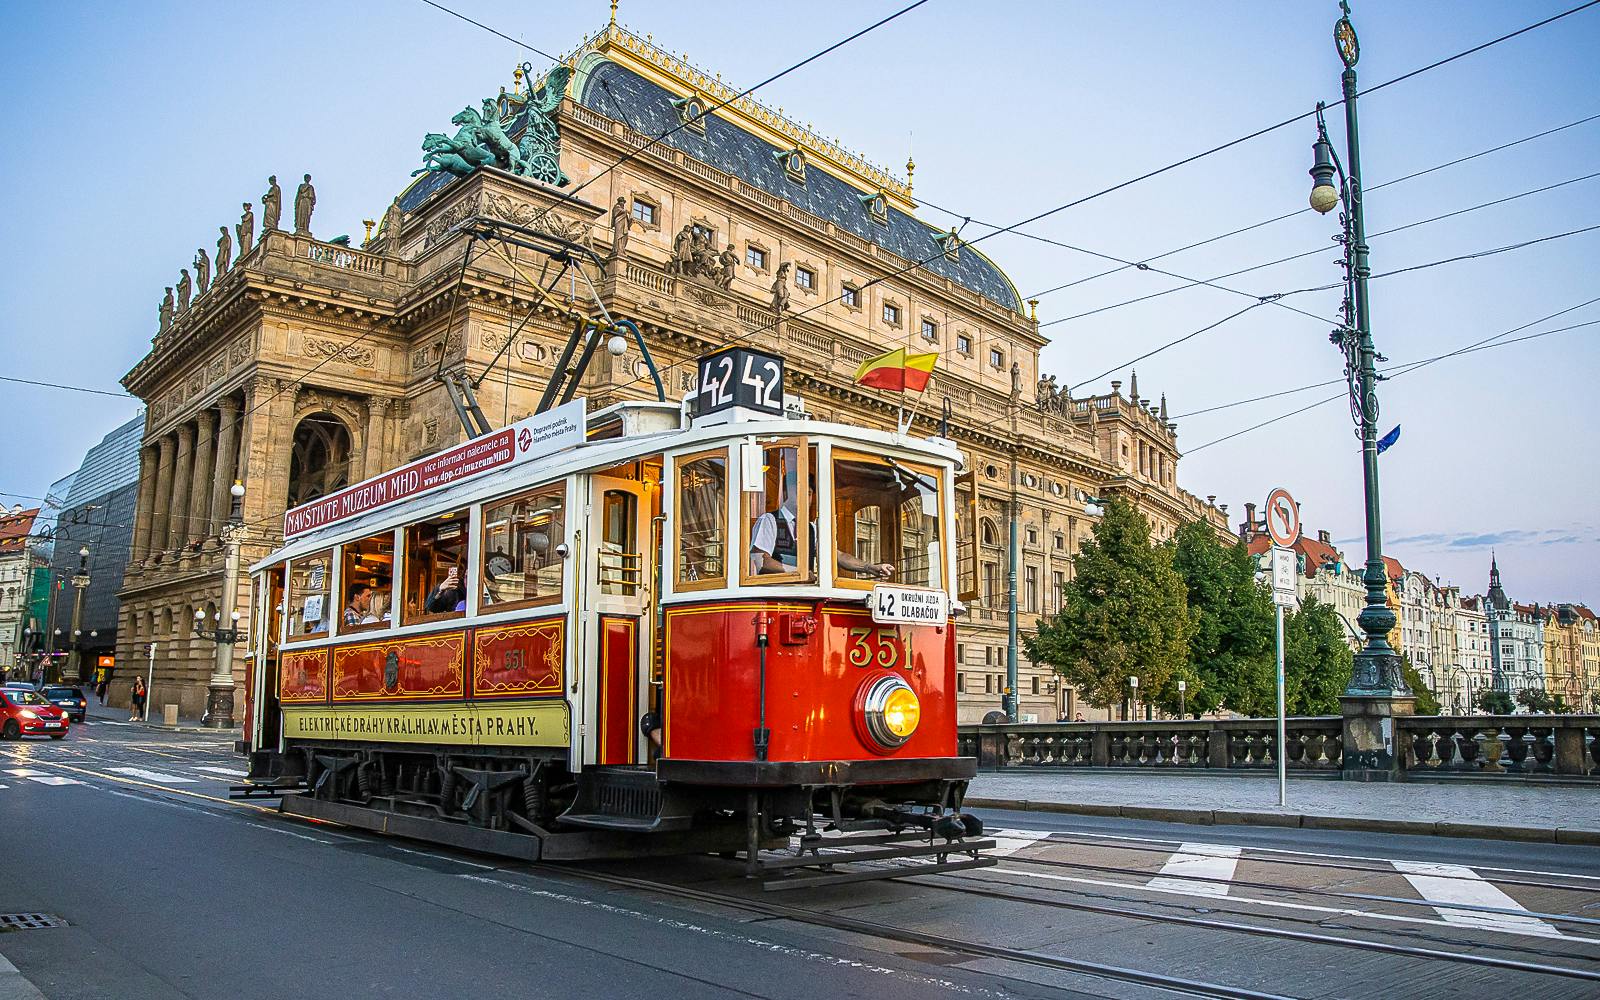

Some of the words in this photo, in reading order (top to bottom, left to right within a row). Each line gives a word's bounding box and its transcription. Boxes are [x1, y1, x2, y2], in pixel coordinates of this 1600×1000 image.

[701, 356, 733, 408] 42
[741, 355, 781, 409] 42
[499, 436, 509, 447] na
[424, 449, 510, 487] www.dpp.cz/muzeumMHD
[287, 499, 339, 534] NAVŠTIVTE
[342, 480, 387, 516] MUZEUM
[390, 470, 419, 498] MHD
[878, 593, 895, 616] 42
[901, 592, 924, 603] OKRUŽNÍ
[901, 605, 939, 619] DLABAČOV
[849, 627, 913, 670] 351
[299, 715, 351, 732] ELEKTRICKÉ
[354, 715, 384, 733] DRÁHY
[441, 714, 482, 735] MĚSTA
[487, 716, 539, 735] PRAHY.
